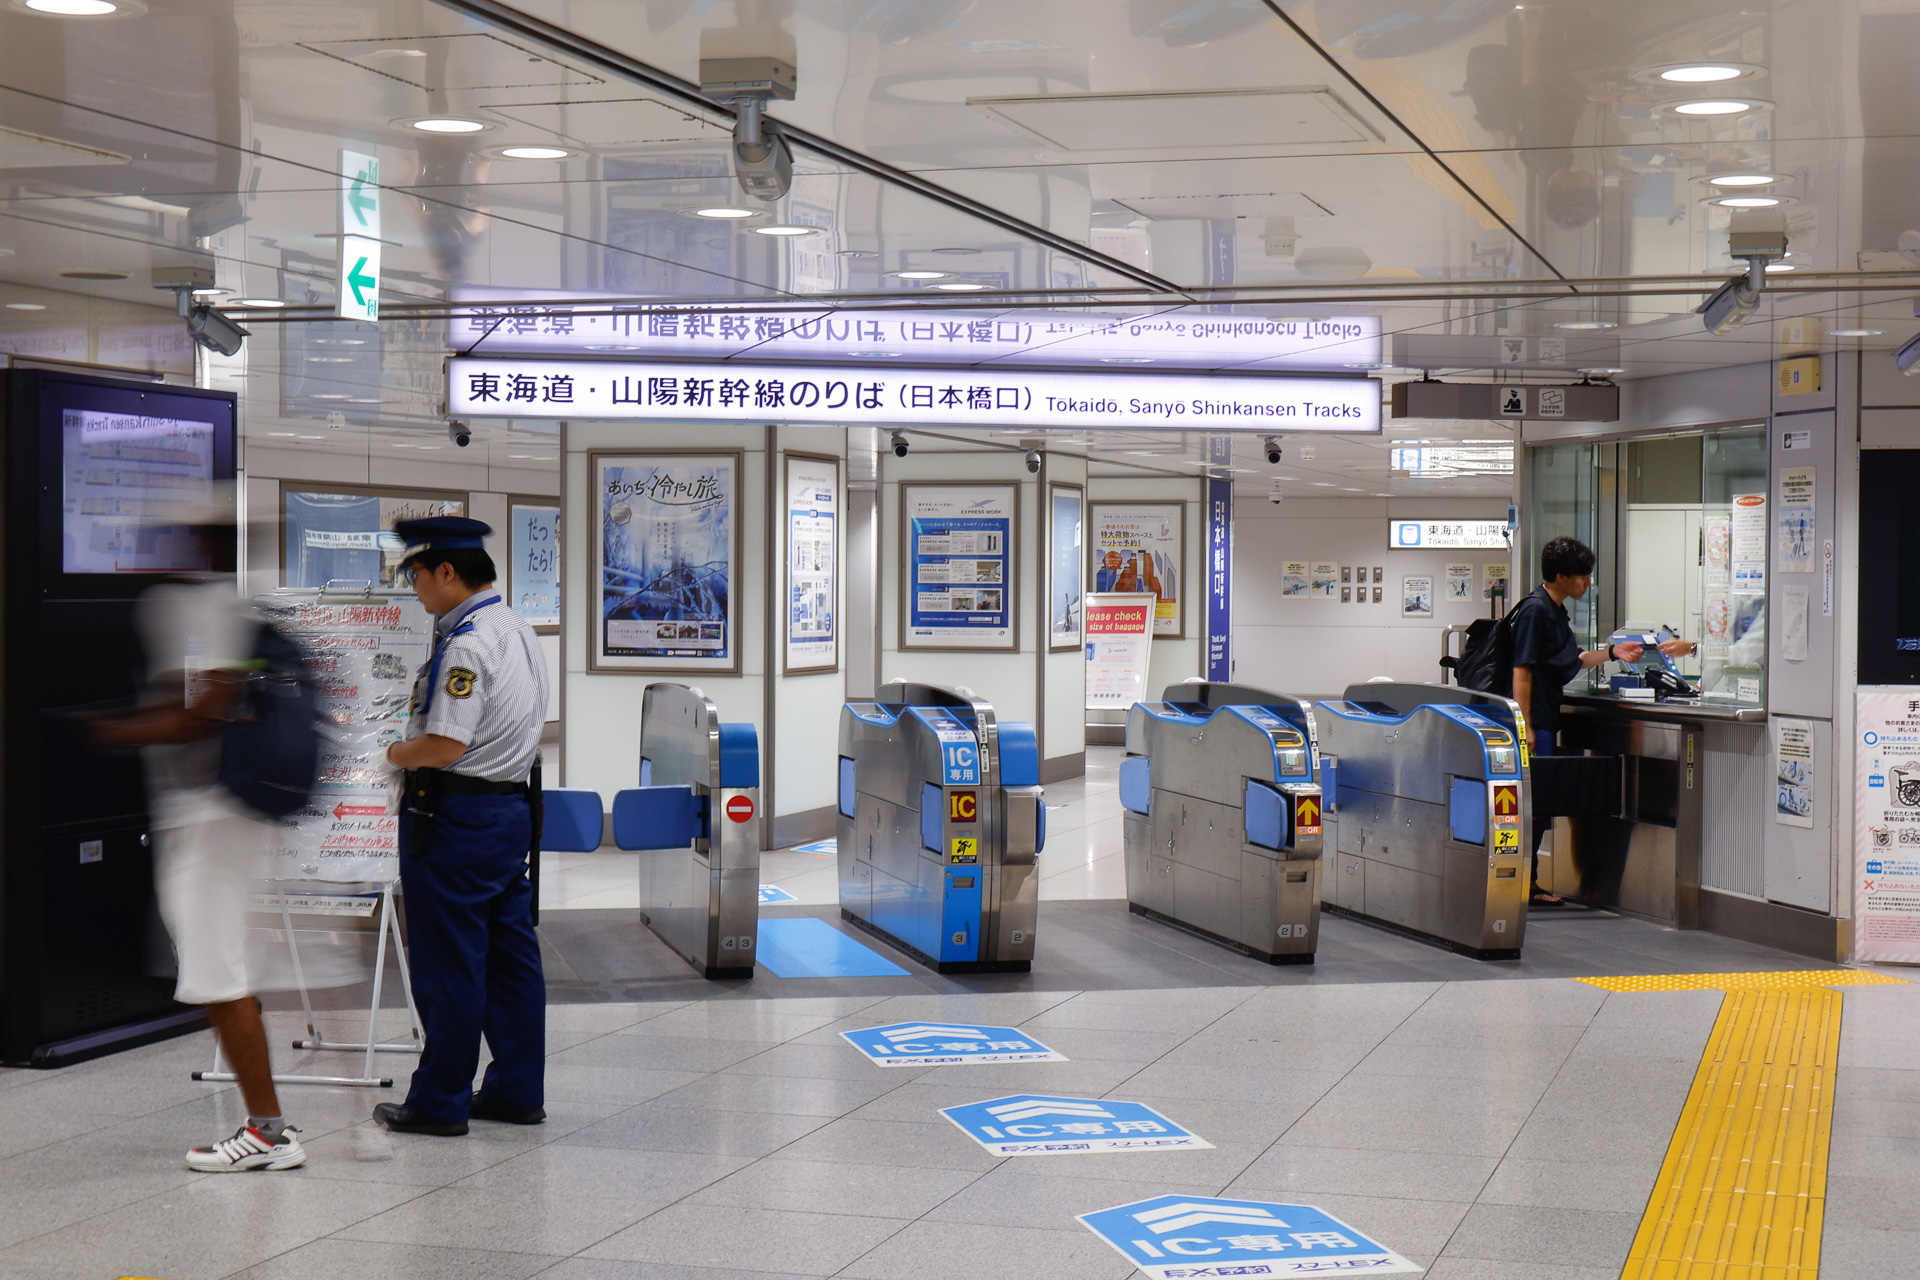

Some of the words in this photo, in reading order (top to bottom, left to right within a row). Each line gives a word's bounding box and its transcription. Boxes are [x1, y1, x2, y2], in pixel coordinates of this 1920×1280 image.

[1046, 396, 1123, 416] Tōkaidō,
[1129, 398, 1186, 420] Sanyō
[1192, 399, 1297, 418] Shinkansen
[1302, 402, 1362, 419] Tracks
[608, 474, 719, 499] あいち冷やし旅
[1101, 530, 1154, 539] 特大荷物スペースと
[1086, 611, 1111, 621] lease
[1114, 610, 1142, 621] check
[1089, 623, 1104, 631] size
[1105, 622, 1114, 631] of
[1114, 623, 1145, 632] baggage
[948, 746, 973, 767] IC
[949, 769, 974, 781] 専用
[950, 795, 976, 818] IC
[1307, 826, 1319, 834] QR
[1280, 926, 1289, 936] 2
[725, 938, 734, 949] 4
[740, 938, 750, 949] 3
[955, 933, 964, 943] 3
[1013, 933, 1022, 943] 2
[980, 1120, 1168, 1138] IC専用
[1131, 1231, 1359, 1258] IC専用
[1287, 1258, 1396, 1272] スマートEX
